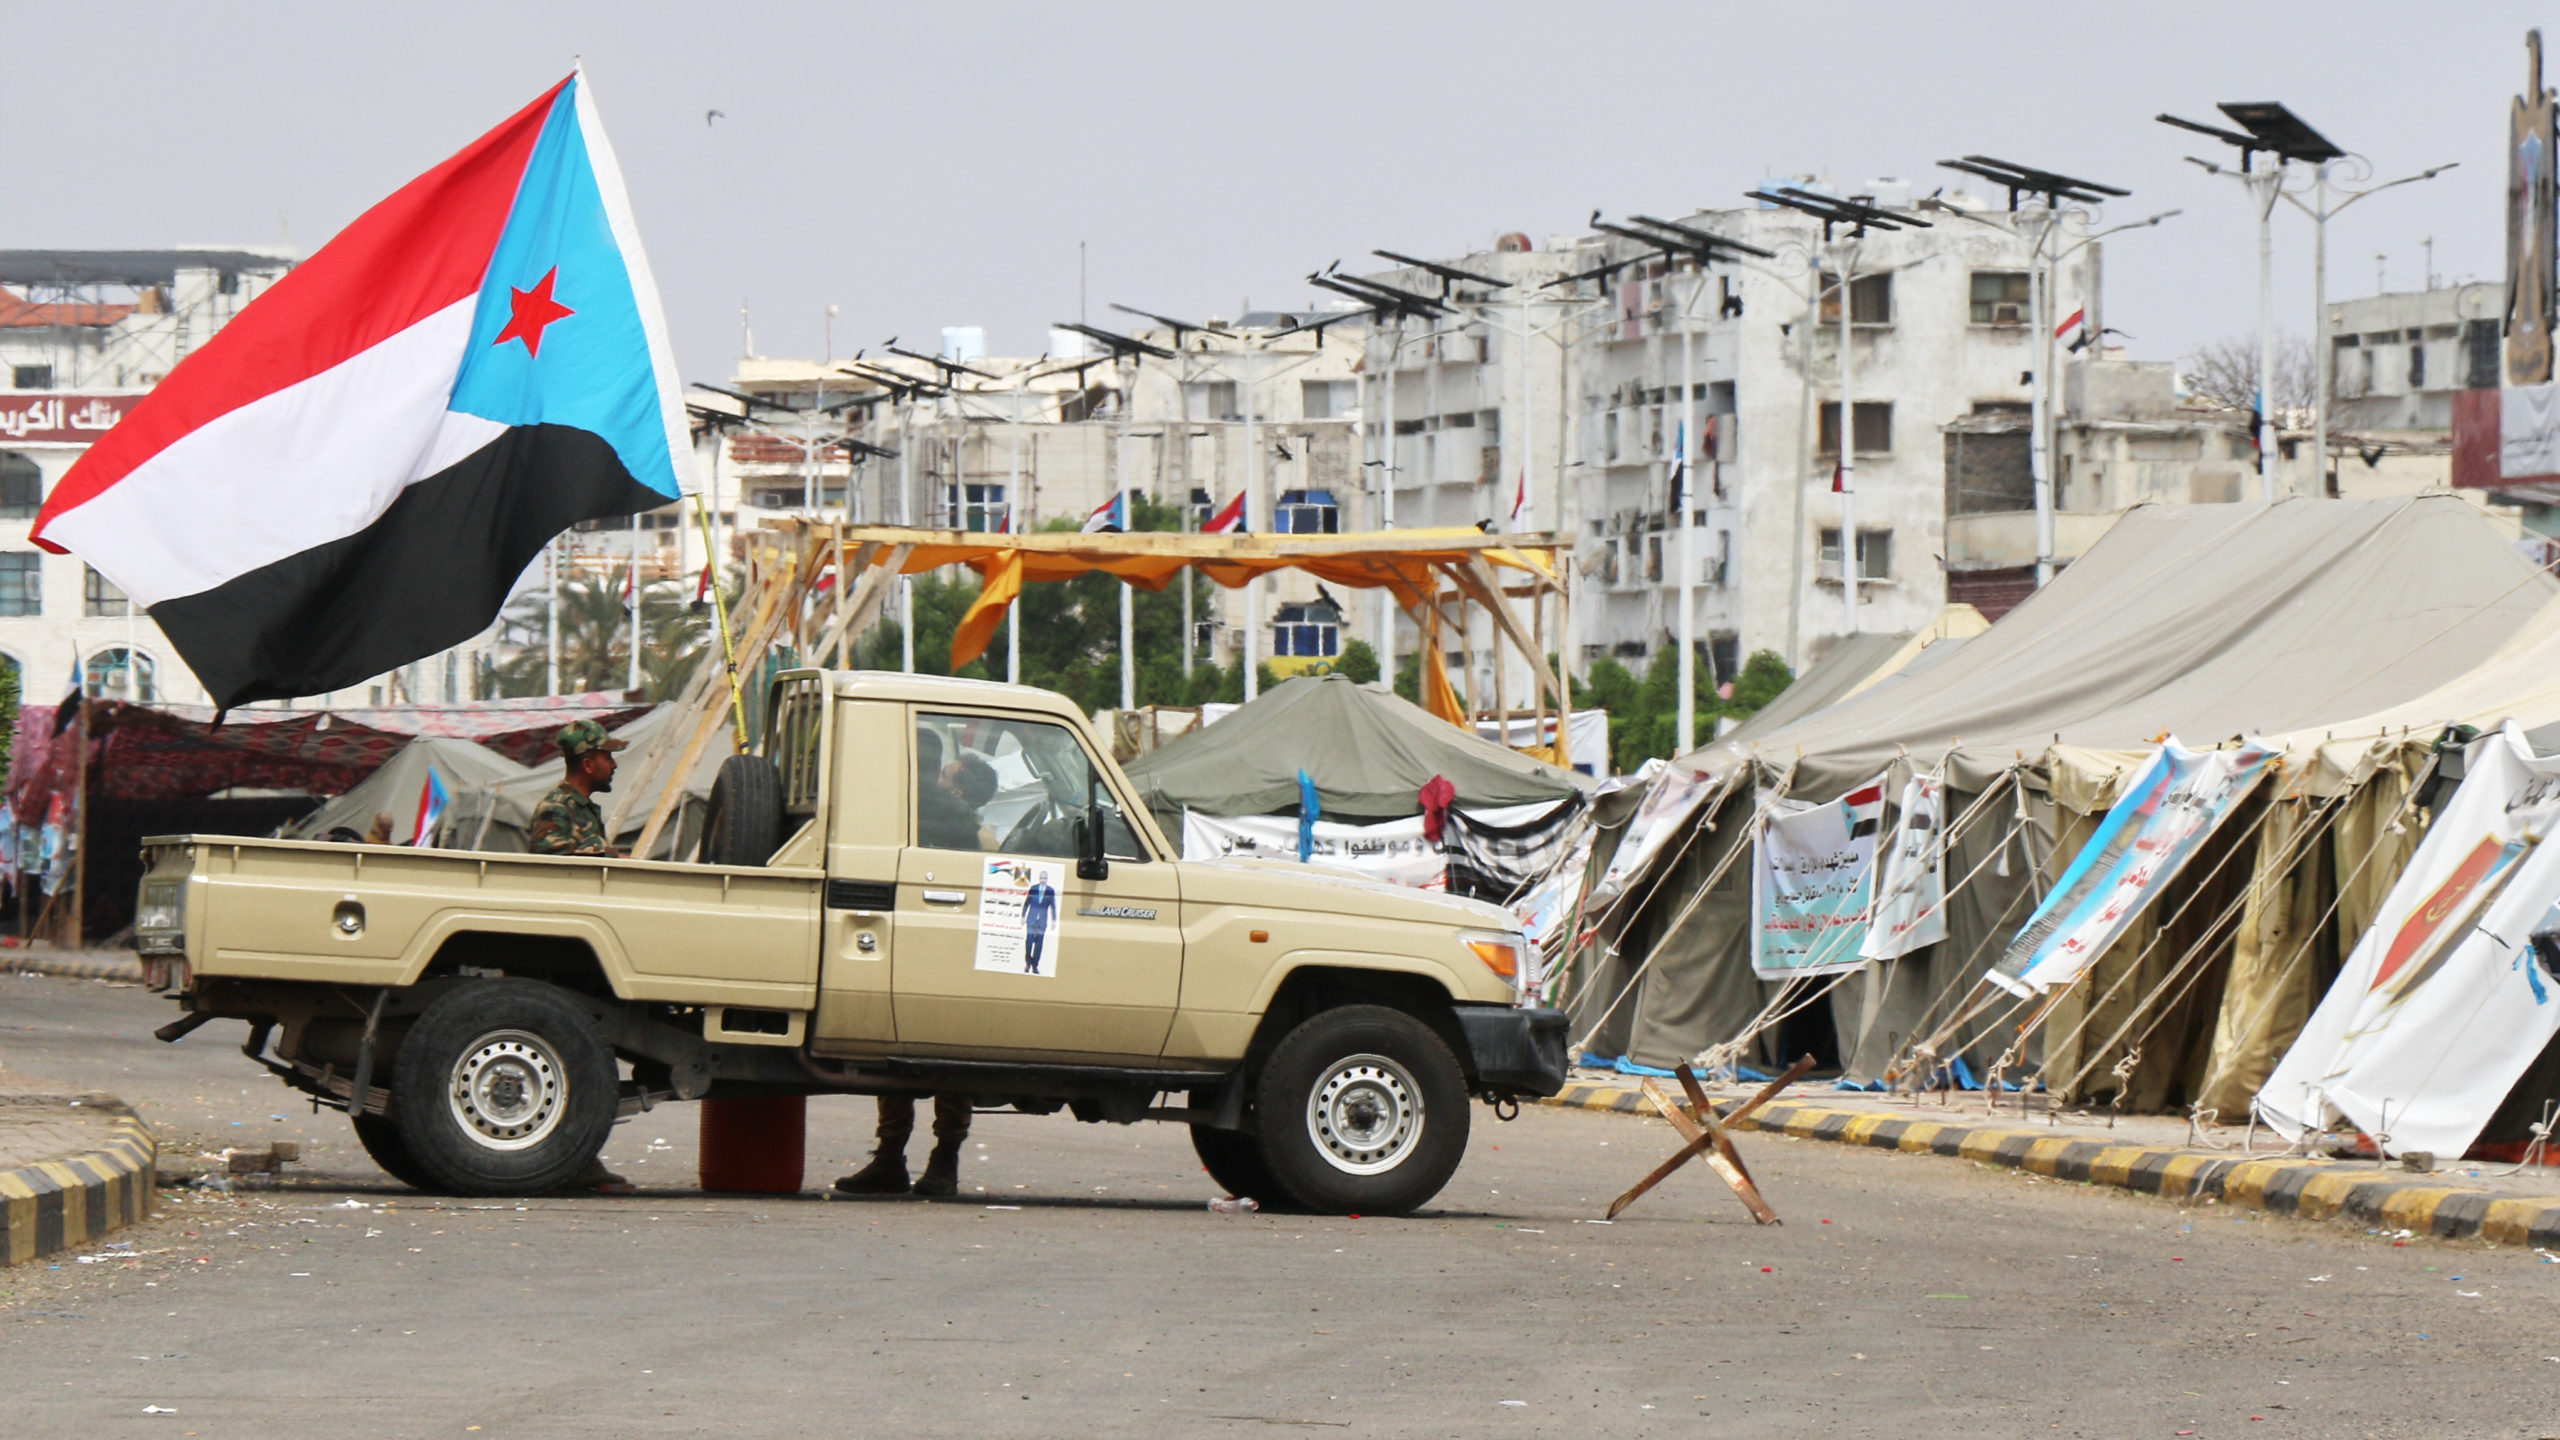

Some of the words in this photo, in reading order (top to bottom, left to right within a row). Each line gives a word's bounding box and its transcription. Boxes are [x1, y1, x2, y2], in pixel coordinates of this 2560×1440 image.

[0, 399, 65, 437] الكري
[1100, 906, 1121, 917] LAND
[1120, 906, 1157, 919] CRUISER
